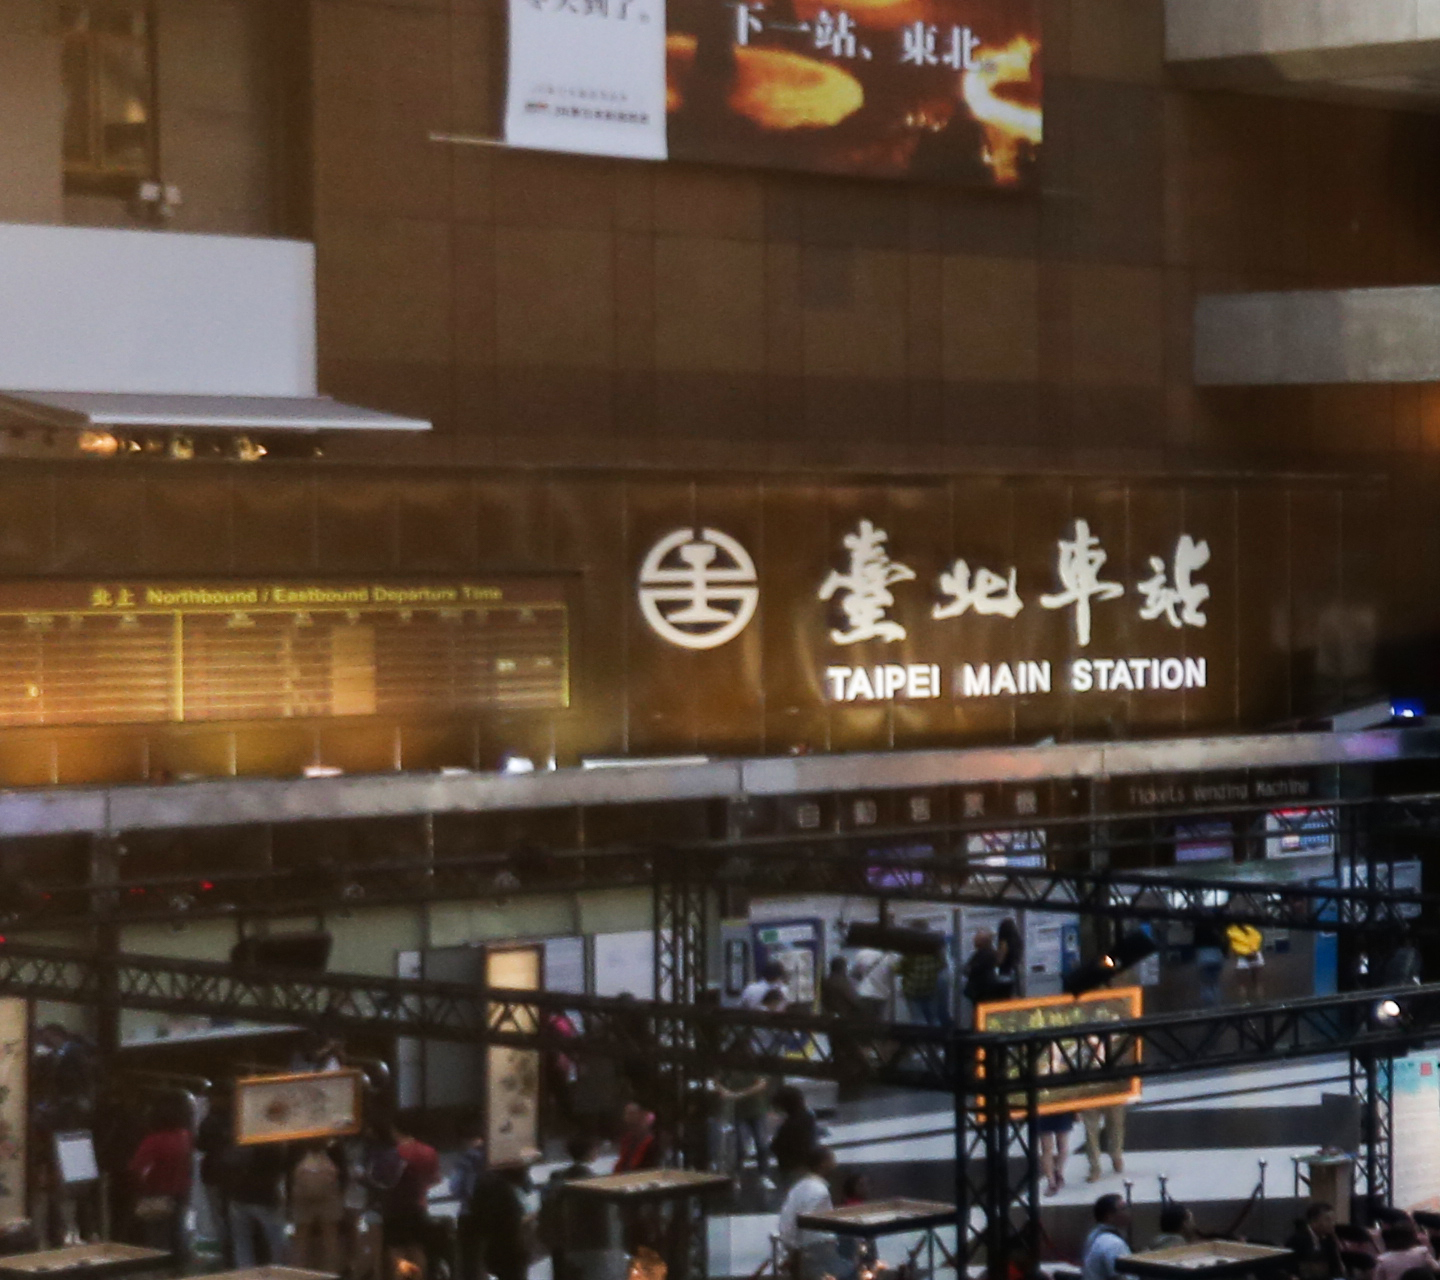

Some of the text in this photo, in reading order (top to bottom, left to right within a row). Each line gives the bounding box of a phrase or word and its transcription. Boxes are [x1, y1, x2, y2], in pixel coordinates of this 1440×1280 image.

[146, 587, 257, 604] Northbound
[273, 587, 369, 603] Eastbound
[374, 586, 457, 604] Departure
[819, 520, 1211, 646] 臺北車站
[827, 657, 1207, 701] TAIPEI MAIN STATION
